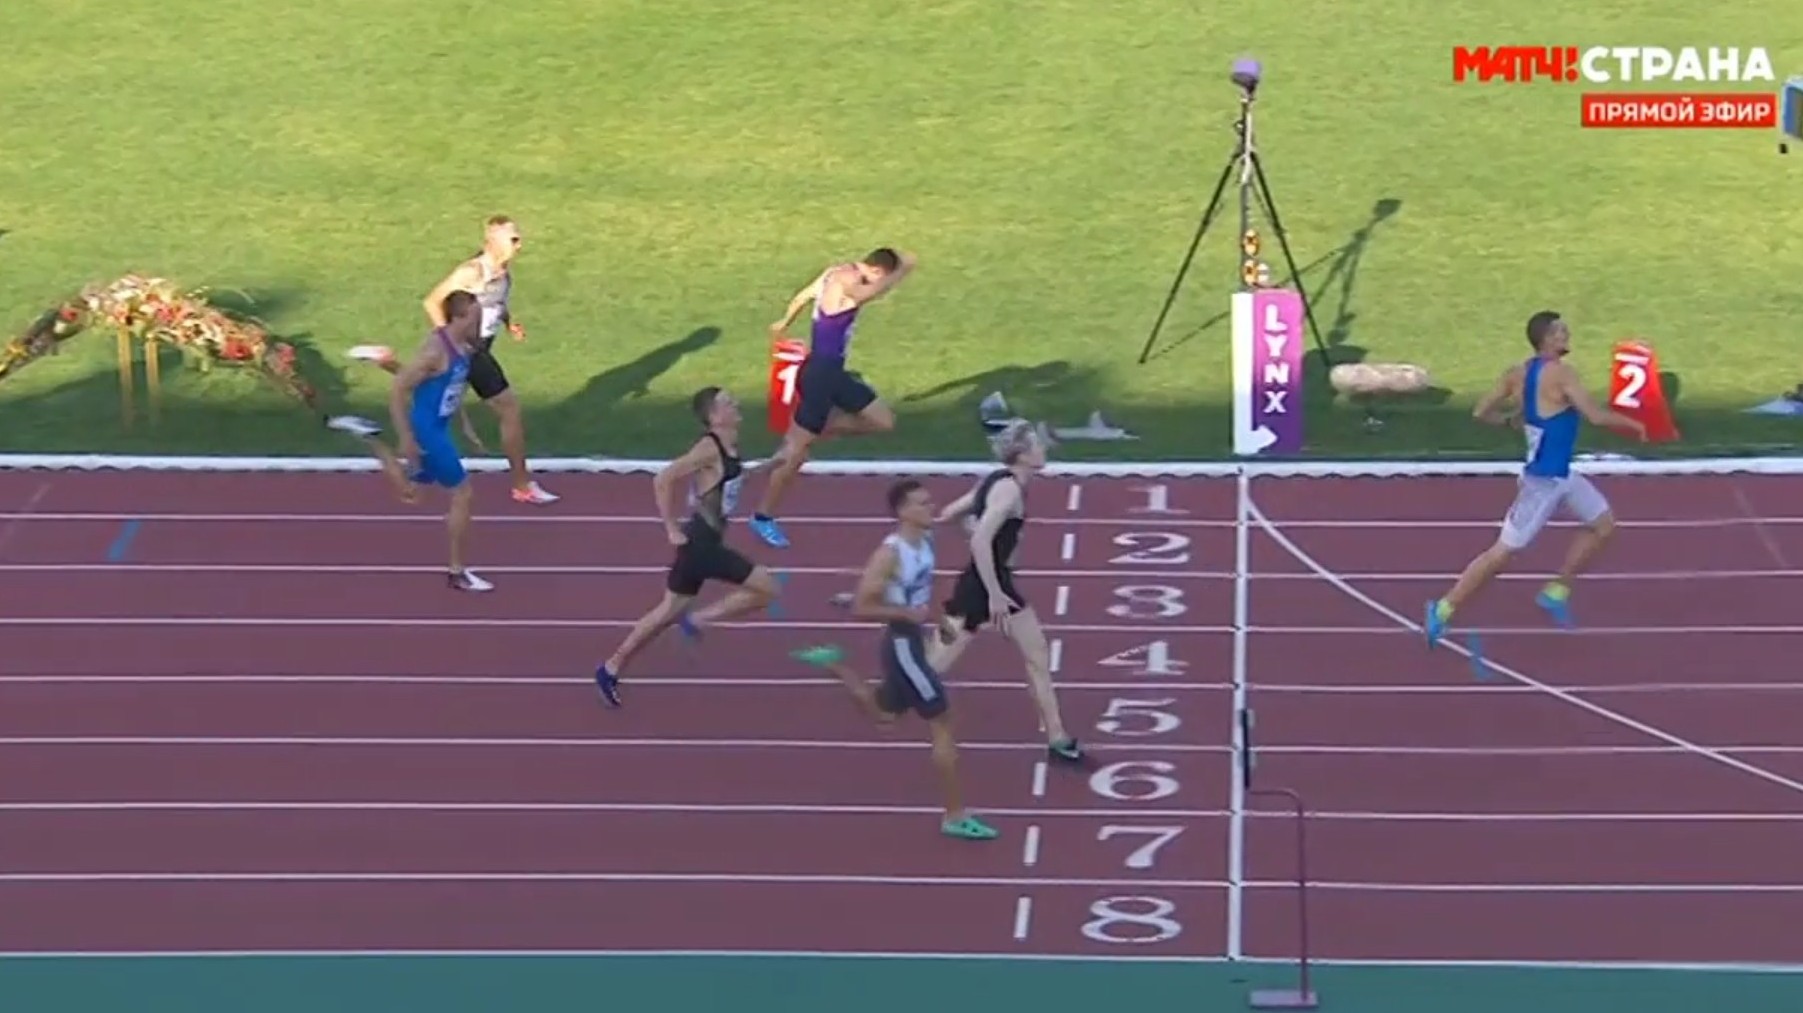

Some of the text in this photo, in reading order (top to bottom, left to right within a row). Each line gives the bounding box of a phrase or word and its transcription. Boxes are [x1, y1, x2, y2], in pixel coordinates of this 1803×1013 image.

[1263, 304, 1290, 413] LYNX
[776, 365, 800, 404] 1
[1613, 363, 1647, 409] 2
[1126, 485, 1190, 514] 1
[1107, 531, 1191, 564] 2
[1106, 585, 1188, 619] 3
[1097, 640, 1189, 675] 4
[1096, 698, 1181, 735] 5
[1089, 761, 1180, 800] 6
[1096, 825, 1188, 867] 7
[1081, 896, 1182, 942] 8
